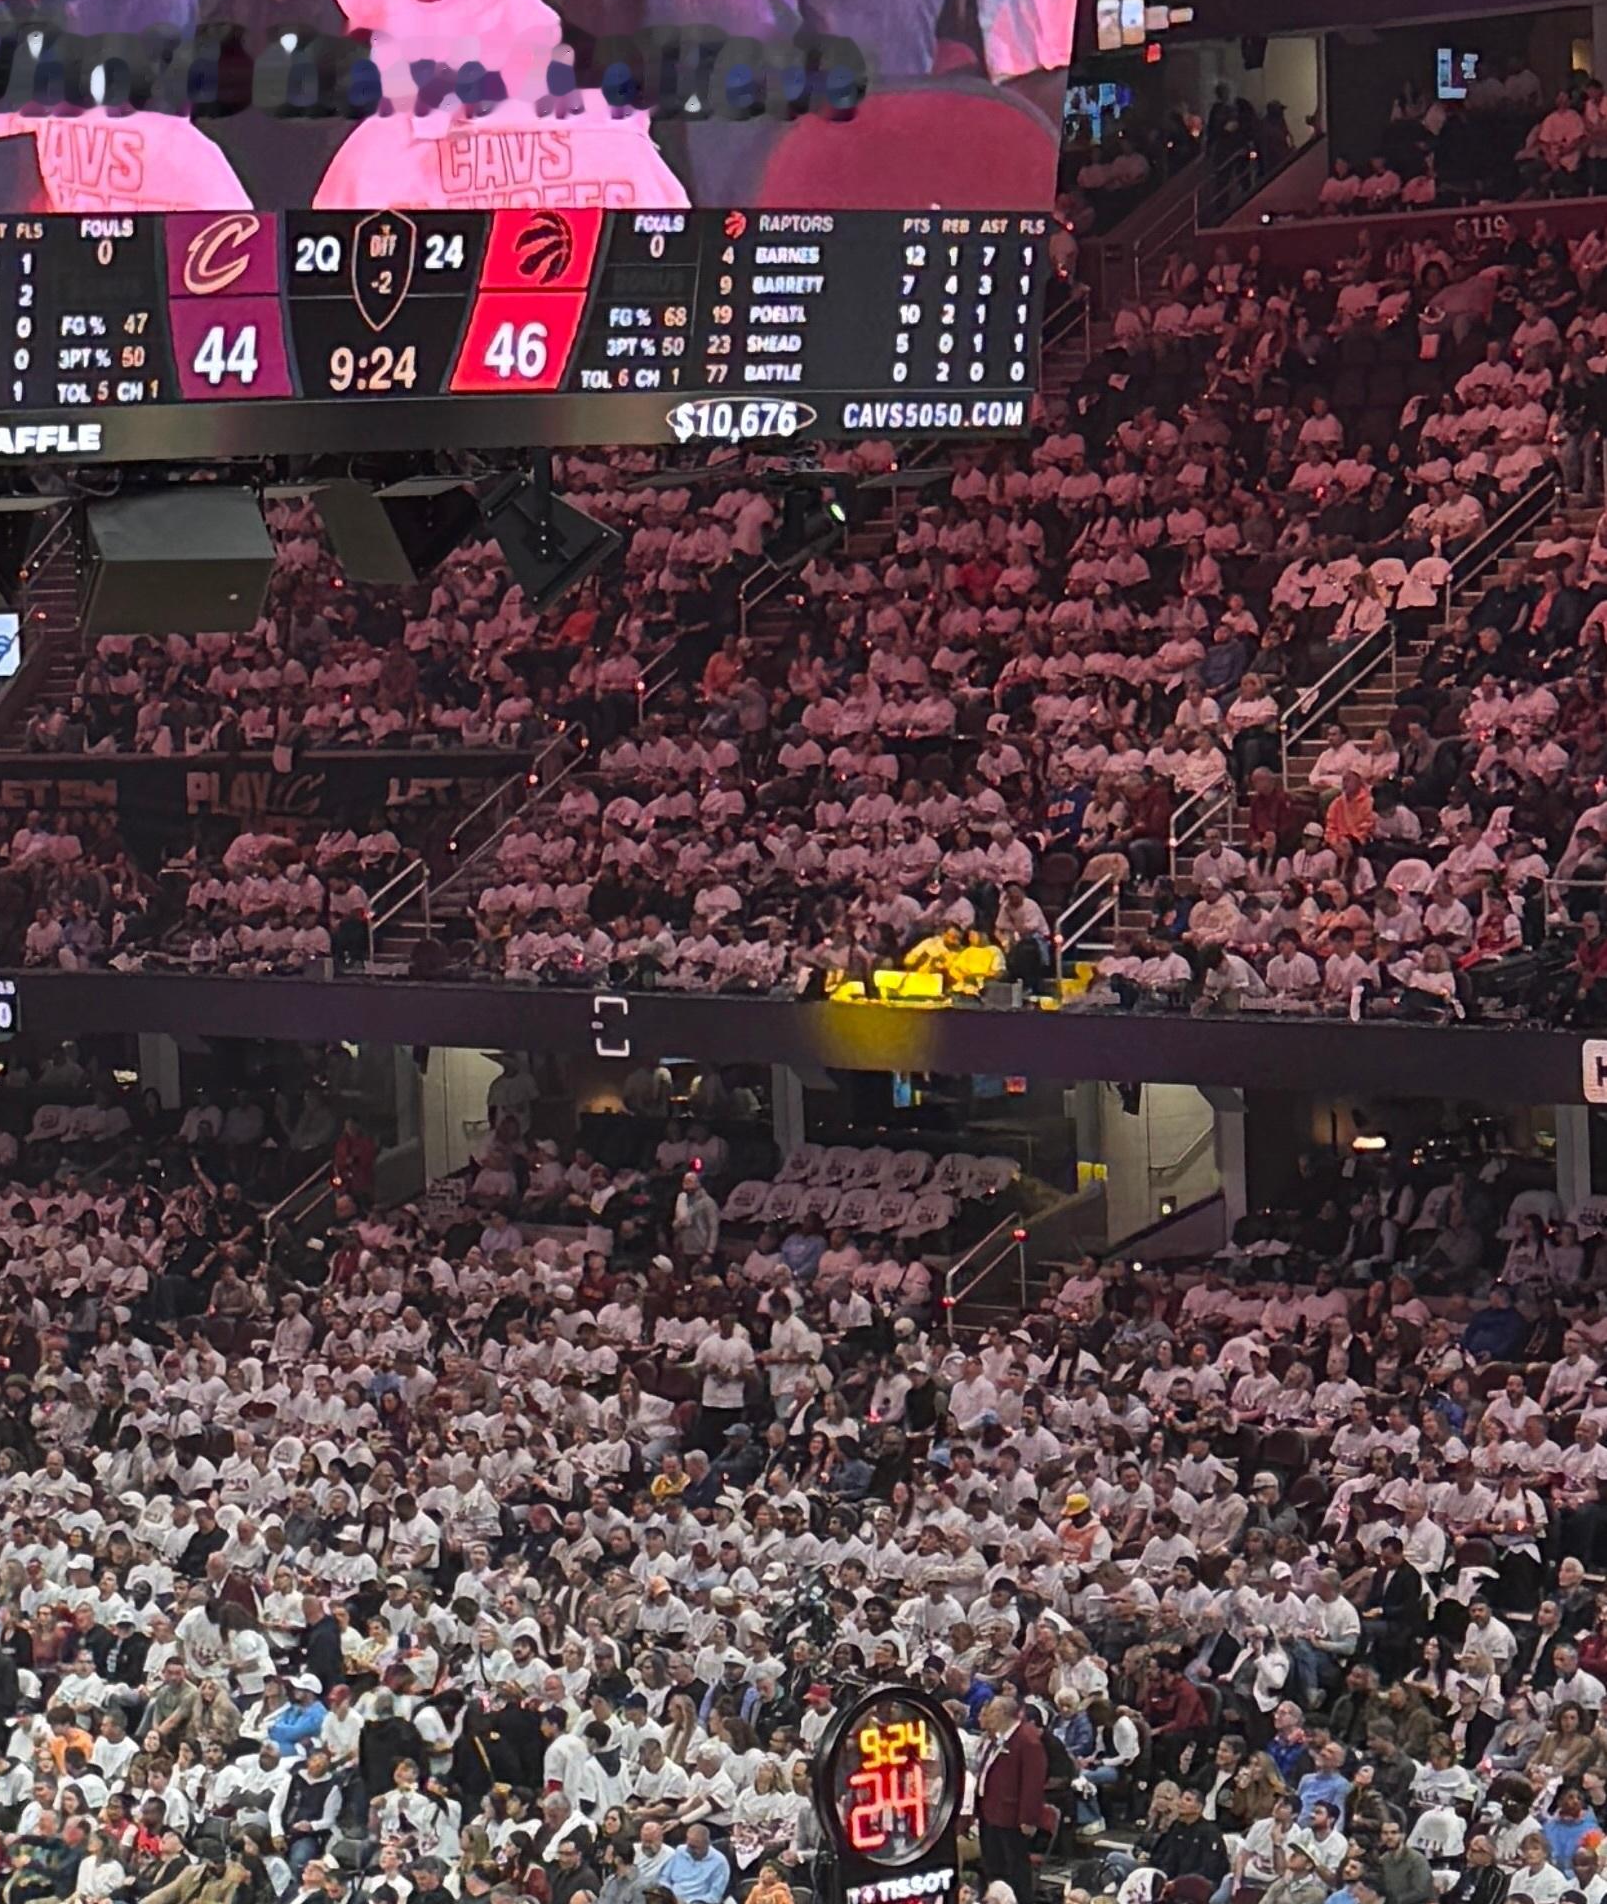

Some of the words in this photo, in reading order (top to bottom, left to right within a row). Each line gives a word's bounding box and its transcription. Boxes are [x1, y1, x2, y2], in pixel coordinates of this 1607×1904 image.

[16, 222, 44, 239] FLS
[81, 219, 134, 238] FOULS
[634, 215, 685, 233] FOULS
[759, 215, 834, 233] RAPTORS
[903, 218, 931, 234] PTS
[980, 218, 1008, 234] AST
[1020, 219, 1045, 235] FLS
[97, 240, 113, 264] 0
[295, 237, 341, 273] 2Q
[425, 234, 464, 270] 24
[650, 235, 664, 259] 0
[722, 246, 735, 264] 4
[123, 313, 148, 335] 47
[712, 305, 733, 324] 19
[194, 325, 258, 385] 44
[484, 321, 548, 379] 46
[707, 335, 731, 354] 23
[330, 346, 417, 392] 9:24
[706, 365, 728, 383] 77
[57, 383, 91, 404] TOL
[673, 401, 797, 443] $10,676
[843, 401, 1024, 428] CAVS5050.COM
[860, 1720, 928, 1770] 9:24
[851, 1765, 925, 1849] 24
[877, 1869, 954, 1901] TISSOT
